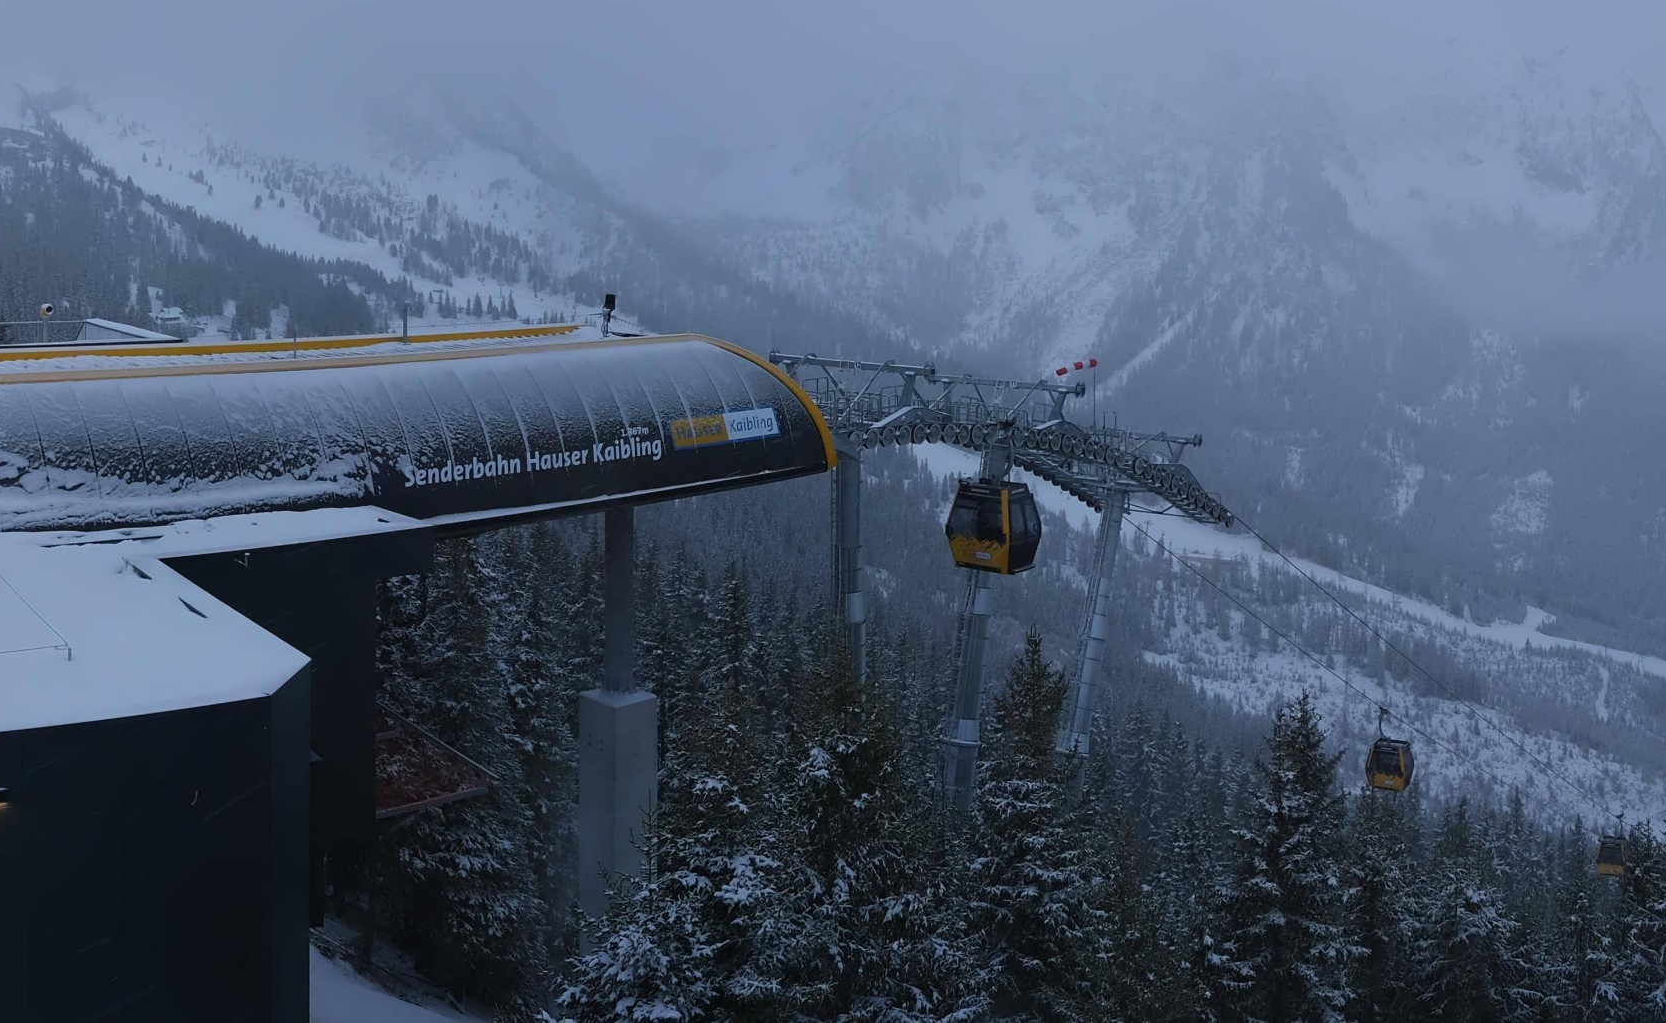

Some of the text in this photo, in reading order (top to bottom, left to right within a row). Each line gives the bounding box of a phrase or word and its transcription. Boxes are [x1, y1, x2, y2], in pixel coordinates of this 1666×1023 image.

[676, 415, 773, 439] HAUSER Kaibling
[404, 438, 662, 488] Senderbahn Hauser Kaibling
